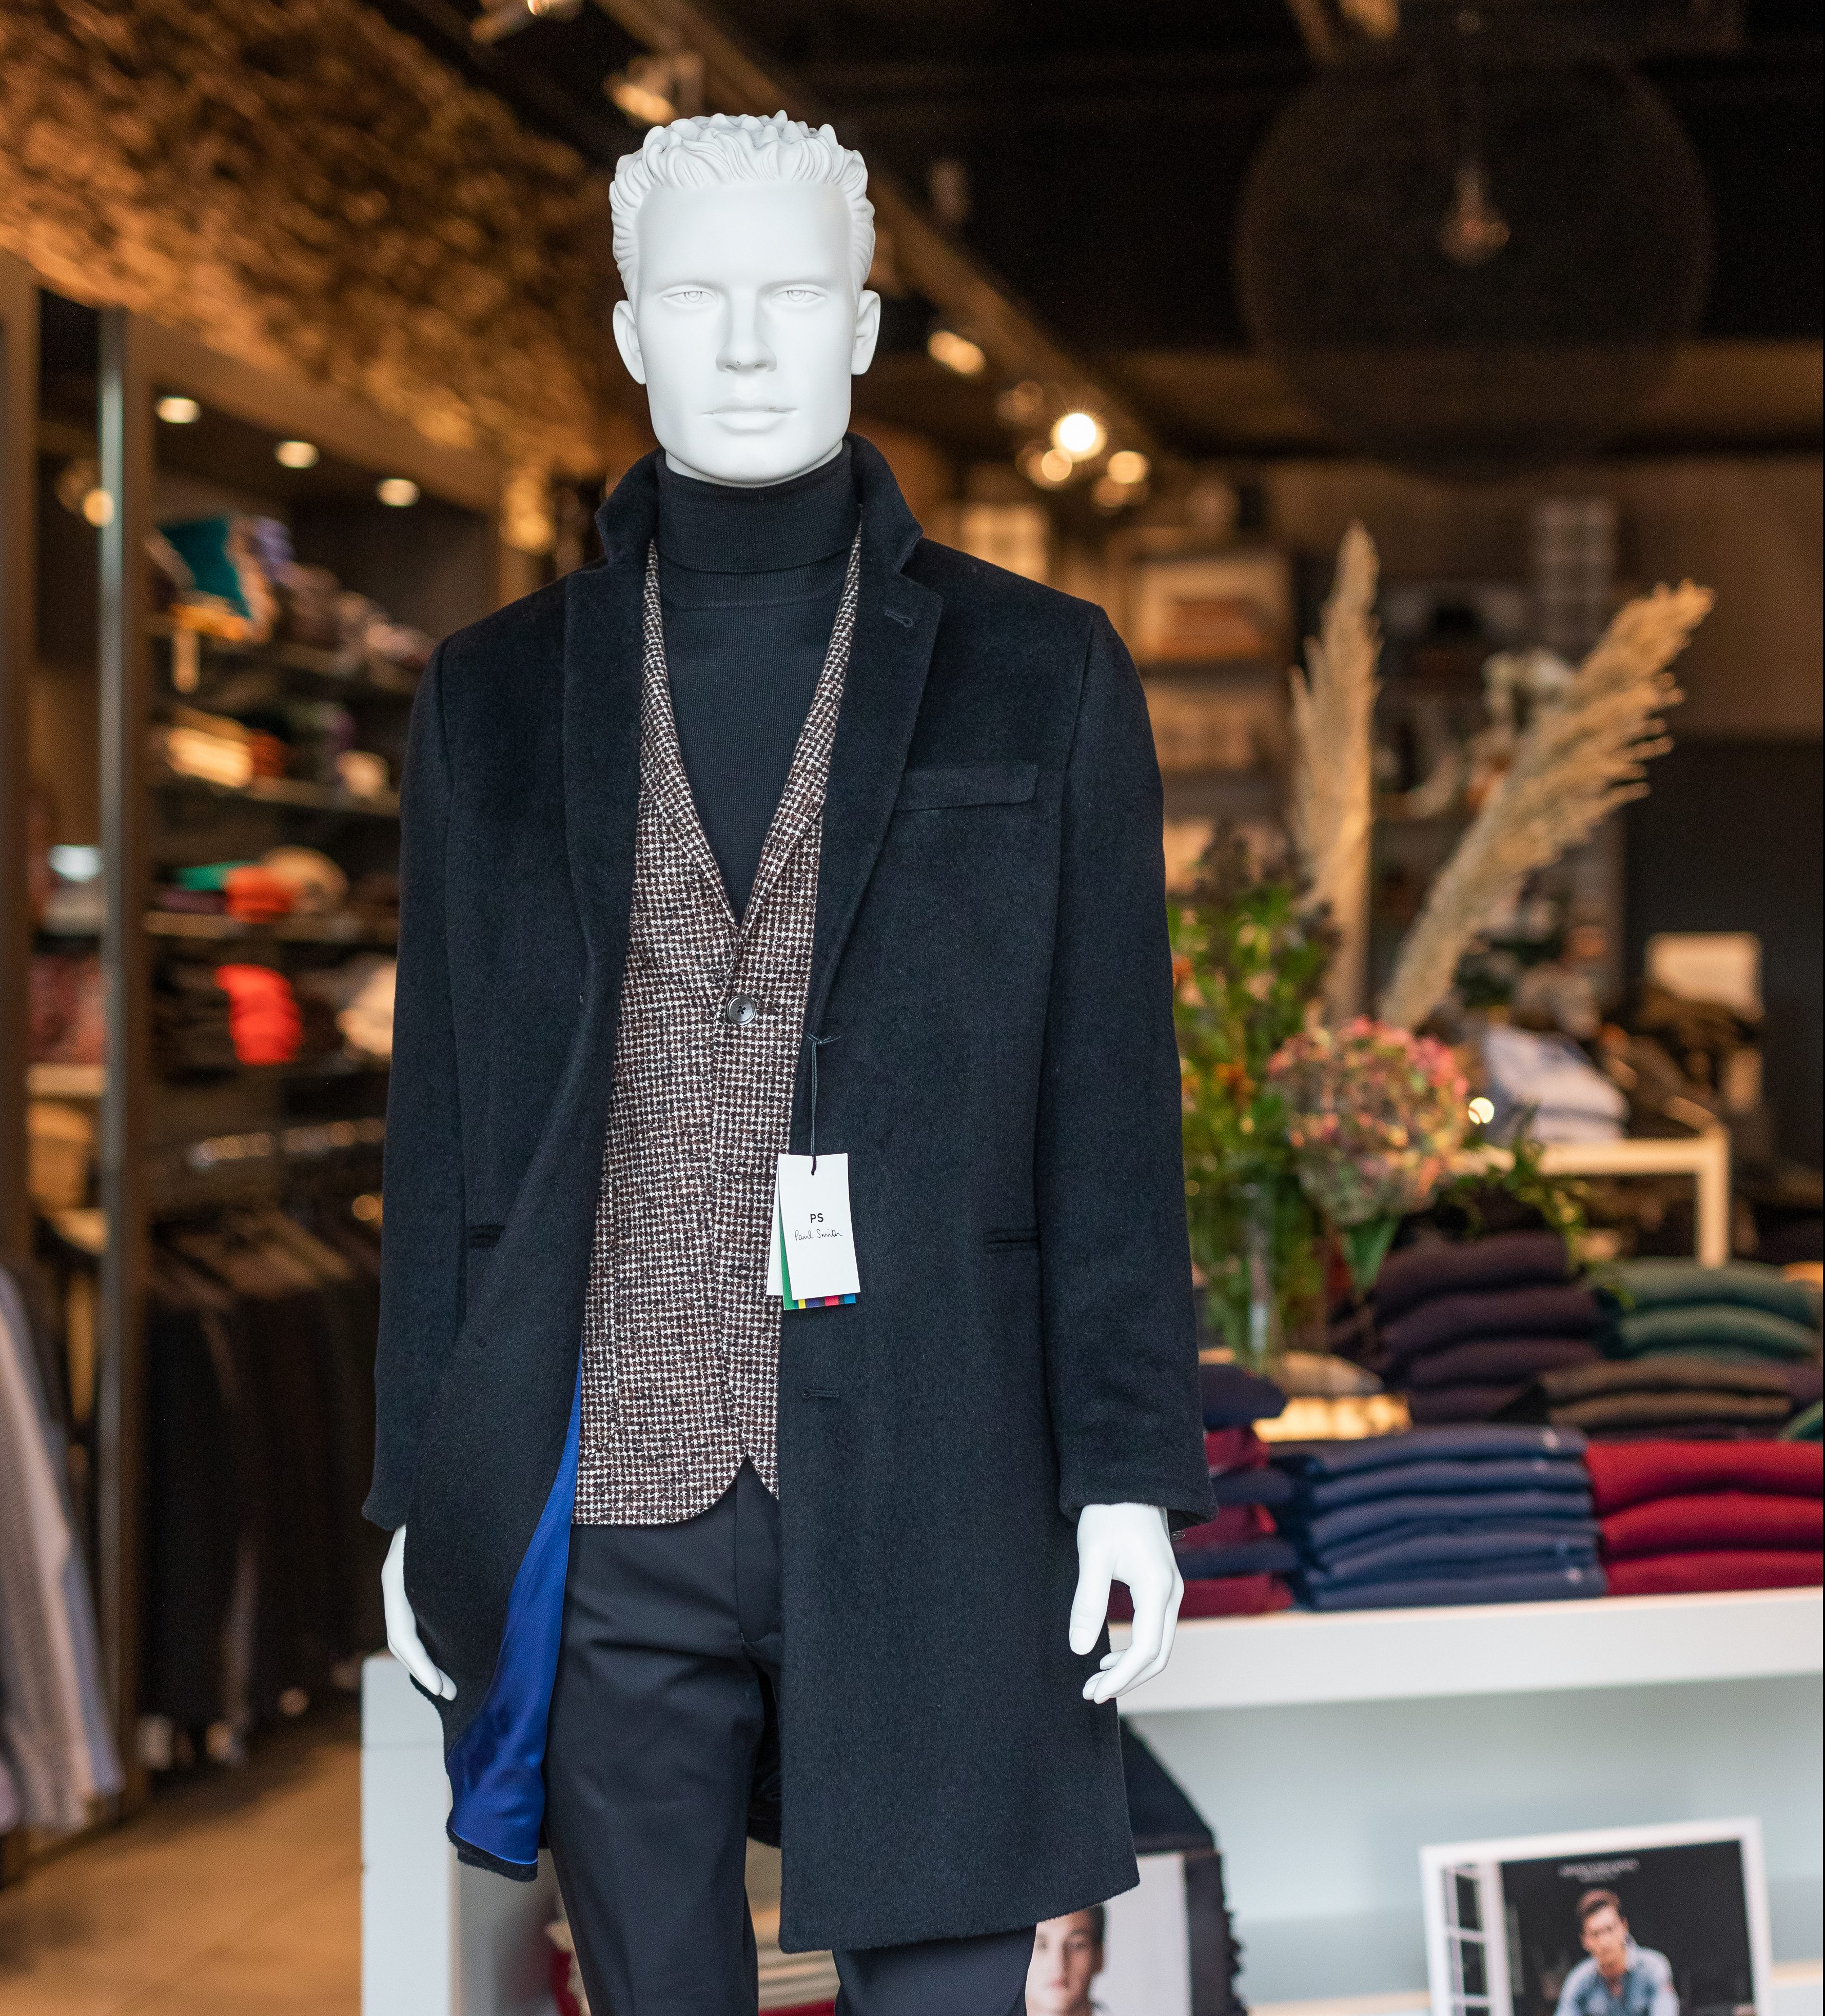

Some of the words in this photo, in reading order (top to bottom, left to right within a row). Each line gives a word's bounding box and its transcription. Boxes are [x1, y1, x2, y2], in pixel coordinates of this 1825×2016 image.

[810, 1213, 824, 1223] PS
[795, 1229, 814, 1241] Paul
[816, 1228, 843, 1238] Smith
